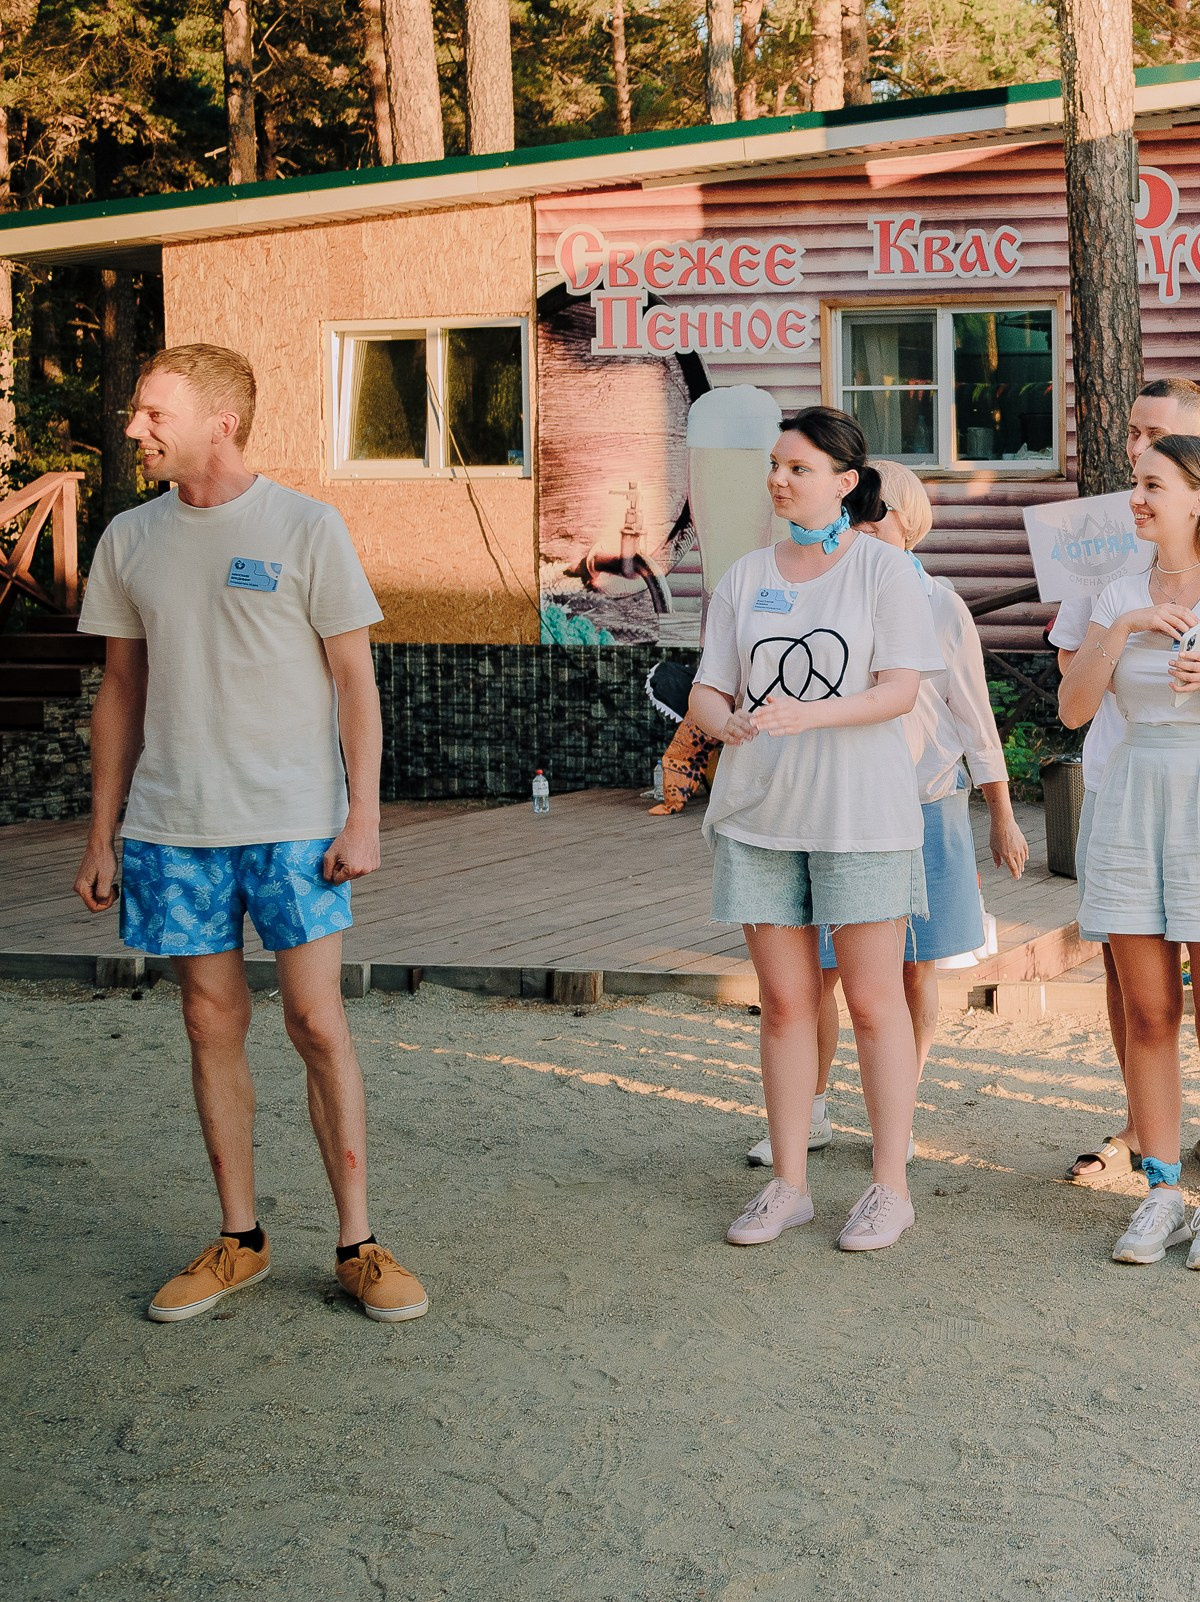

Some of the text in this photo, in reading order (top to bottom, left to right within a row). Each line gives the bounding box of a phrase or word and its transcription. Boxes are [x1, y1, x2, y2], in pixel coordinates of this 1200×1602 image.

[559, 230, 799, 292] Свежее
[871, 217, 1019, 275] Квас
[596, 296, 811, 350] Пенное
[1065, 532, 1139, 560] ОТРЯД
[1068, 565, 1128, 587] СМЕНА 2023
